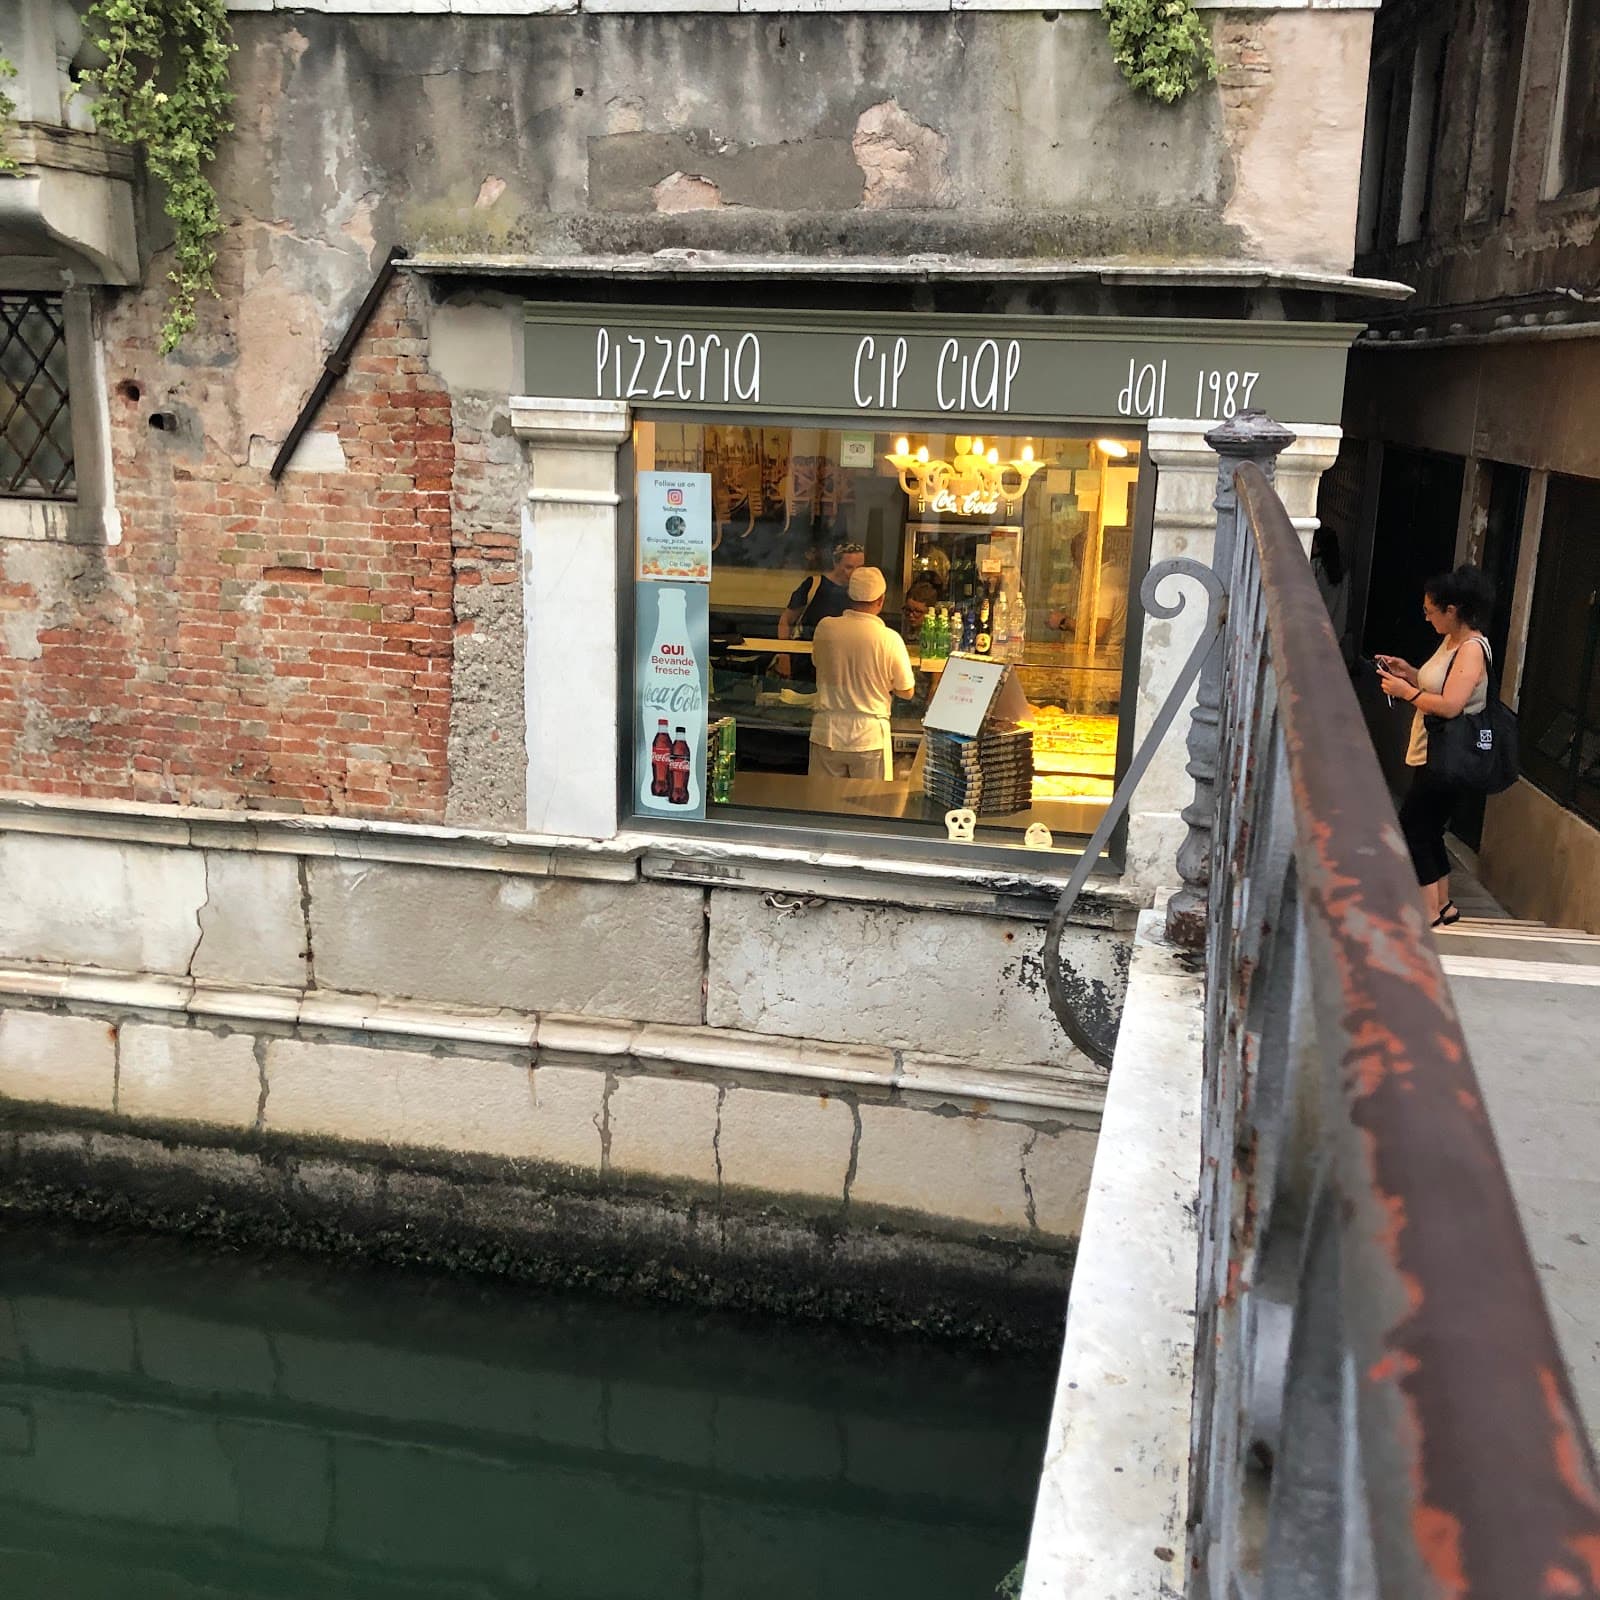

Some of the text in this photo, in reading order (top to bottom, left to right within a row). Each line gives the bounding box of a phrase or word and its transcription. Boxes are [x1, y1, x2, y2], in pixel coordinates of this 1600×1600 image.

[597, 327, 760, 403] Pizzeria
[1118, 358, 1167, 417] dal
[1196, 370, 1260, 418] 1987
[654, 479, 676, 487] Follow
[661, 644, 685, 656] QUI
[651, 655, 694, 667] Bevande
[655, 665, 691, 676] fresche
